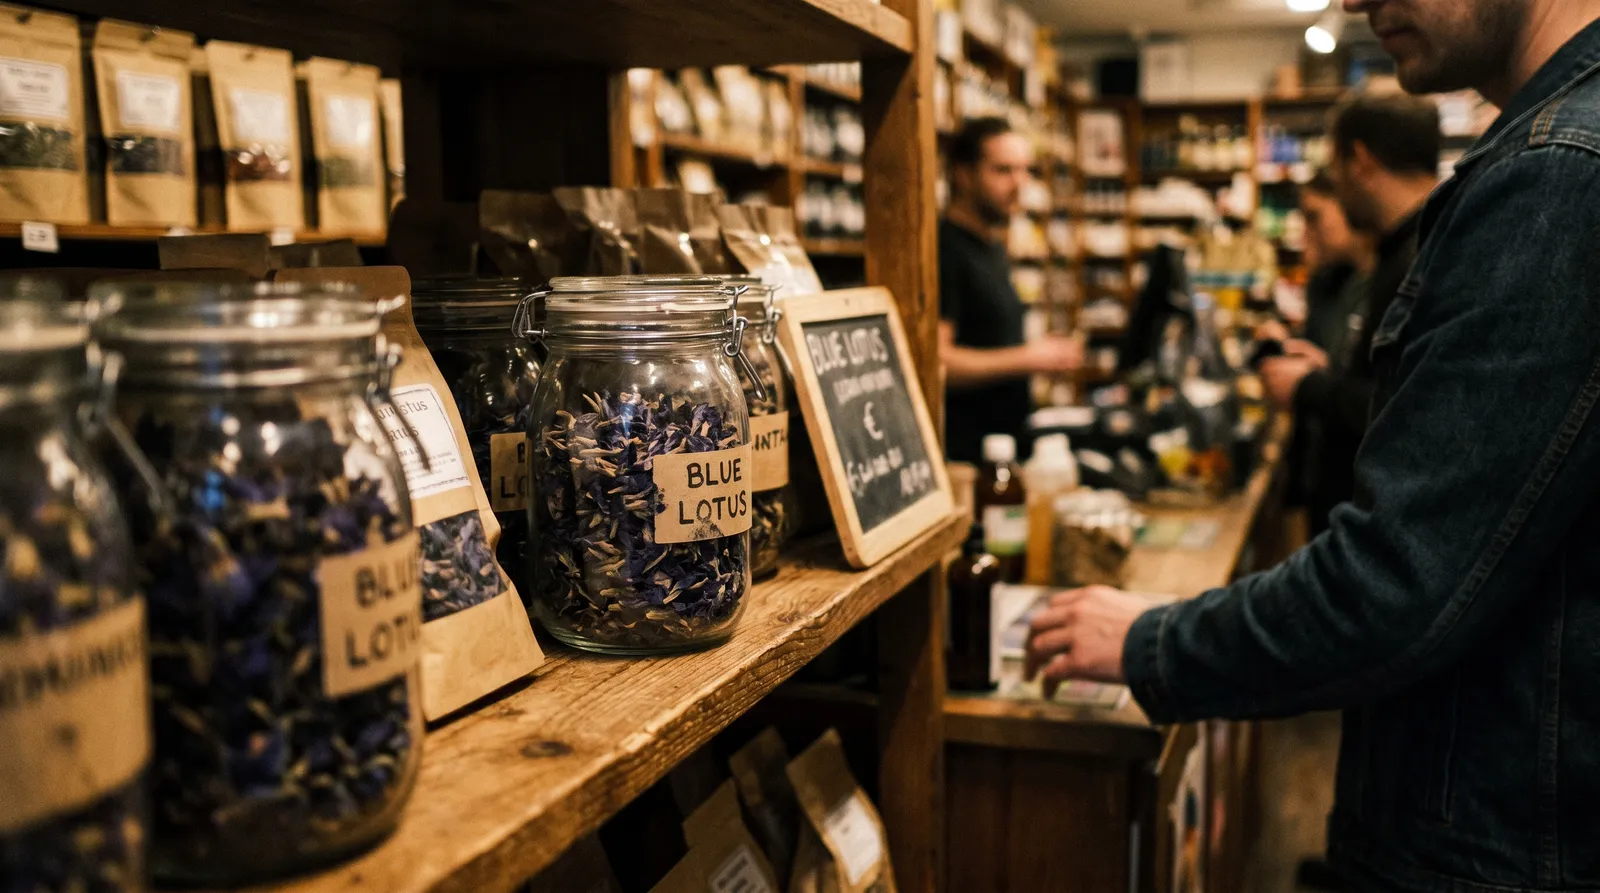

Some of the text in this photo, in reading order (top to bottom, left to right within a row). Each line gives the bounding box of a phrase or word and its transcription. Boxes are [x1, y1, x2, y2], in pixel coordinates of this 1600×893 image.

[806, 331, 847, 375] BLUE
[687, 457, 742, 489] BLUE
[679, 490, 748, 525] LOTUS
